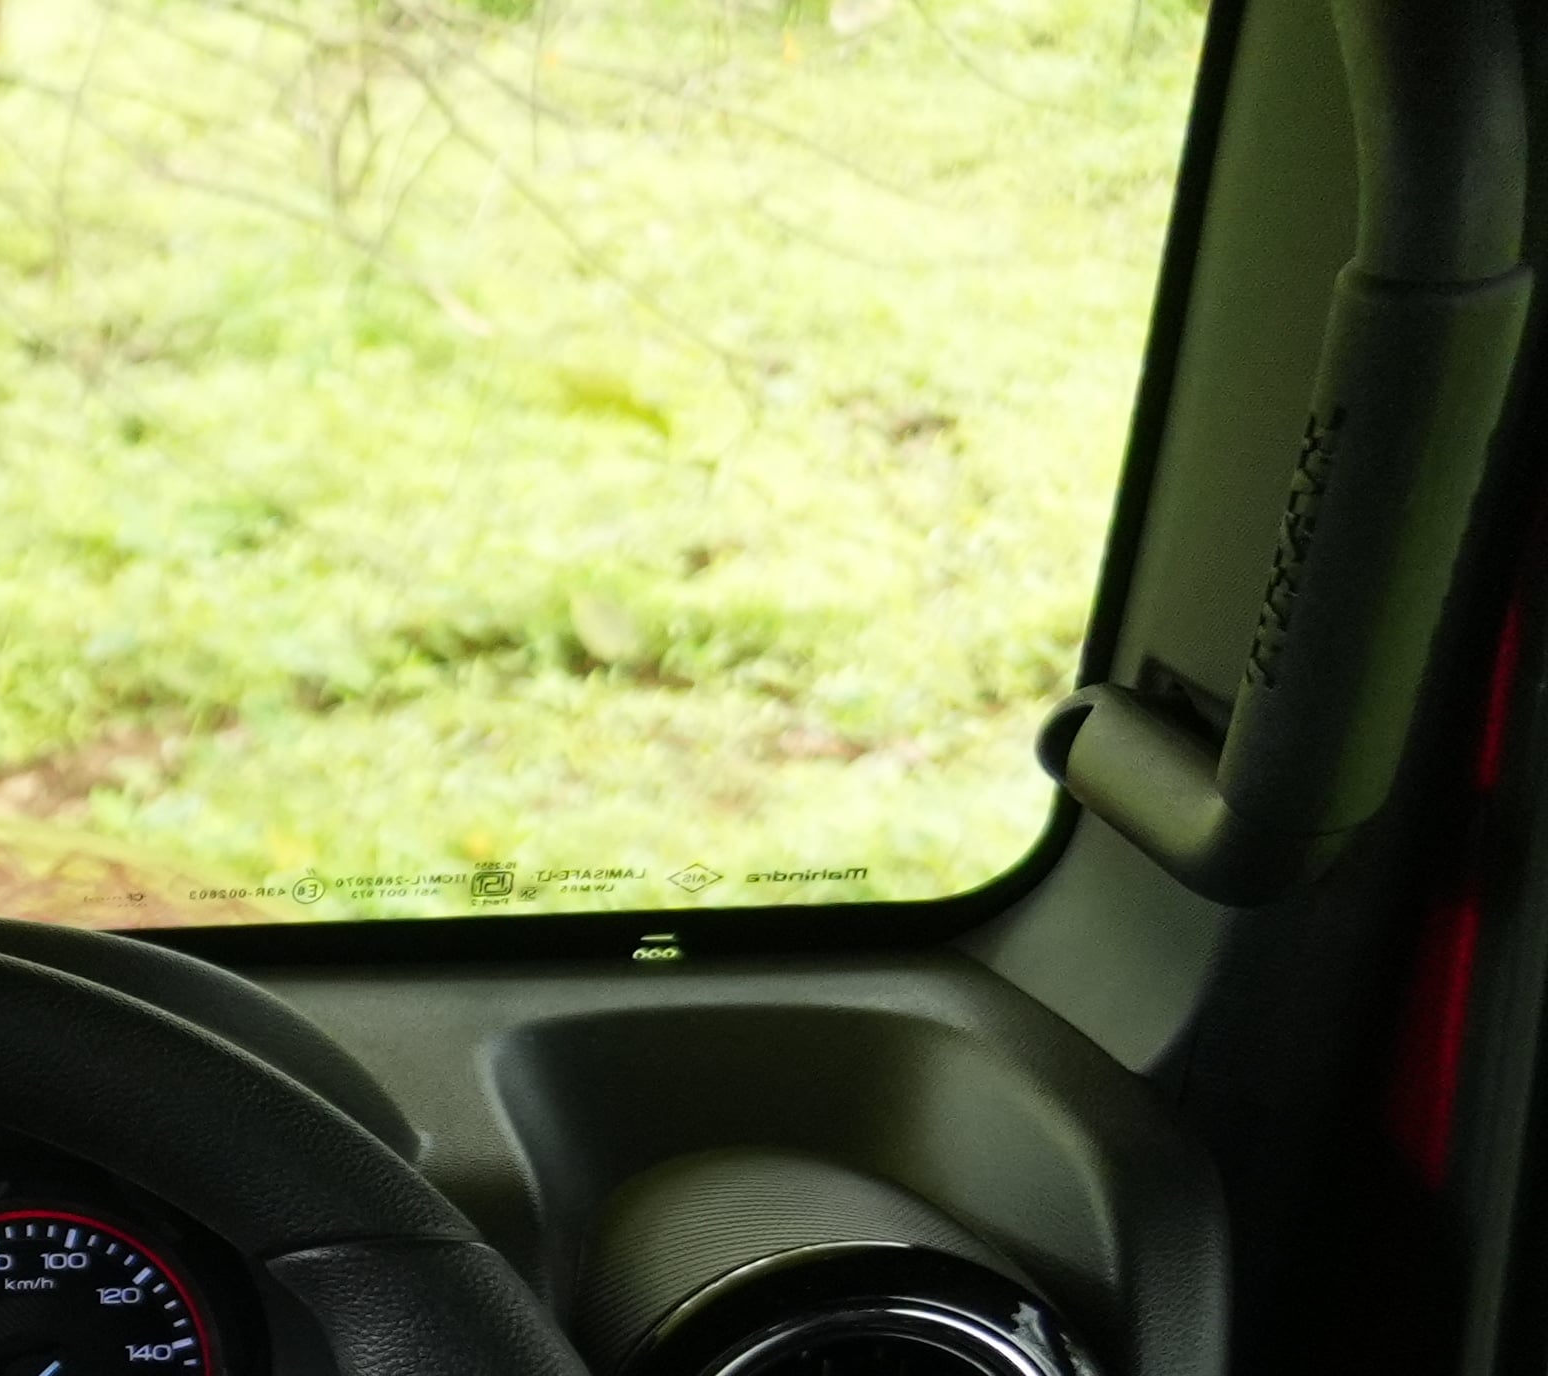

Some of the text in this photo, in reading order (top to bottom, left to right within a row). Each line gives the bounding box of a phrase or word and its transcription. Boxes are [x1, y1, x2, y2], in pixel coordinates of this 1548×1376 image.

[40, 1253, 86, 1269] 100
[4, 1278, 54, 1290] km/h
[96, 1288, 140, 1304] 120
[125, 1344, 172, 1361] 140
